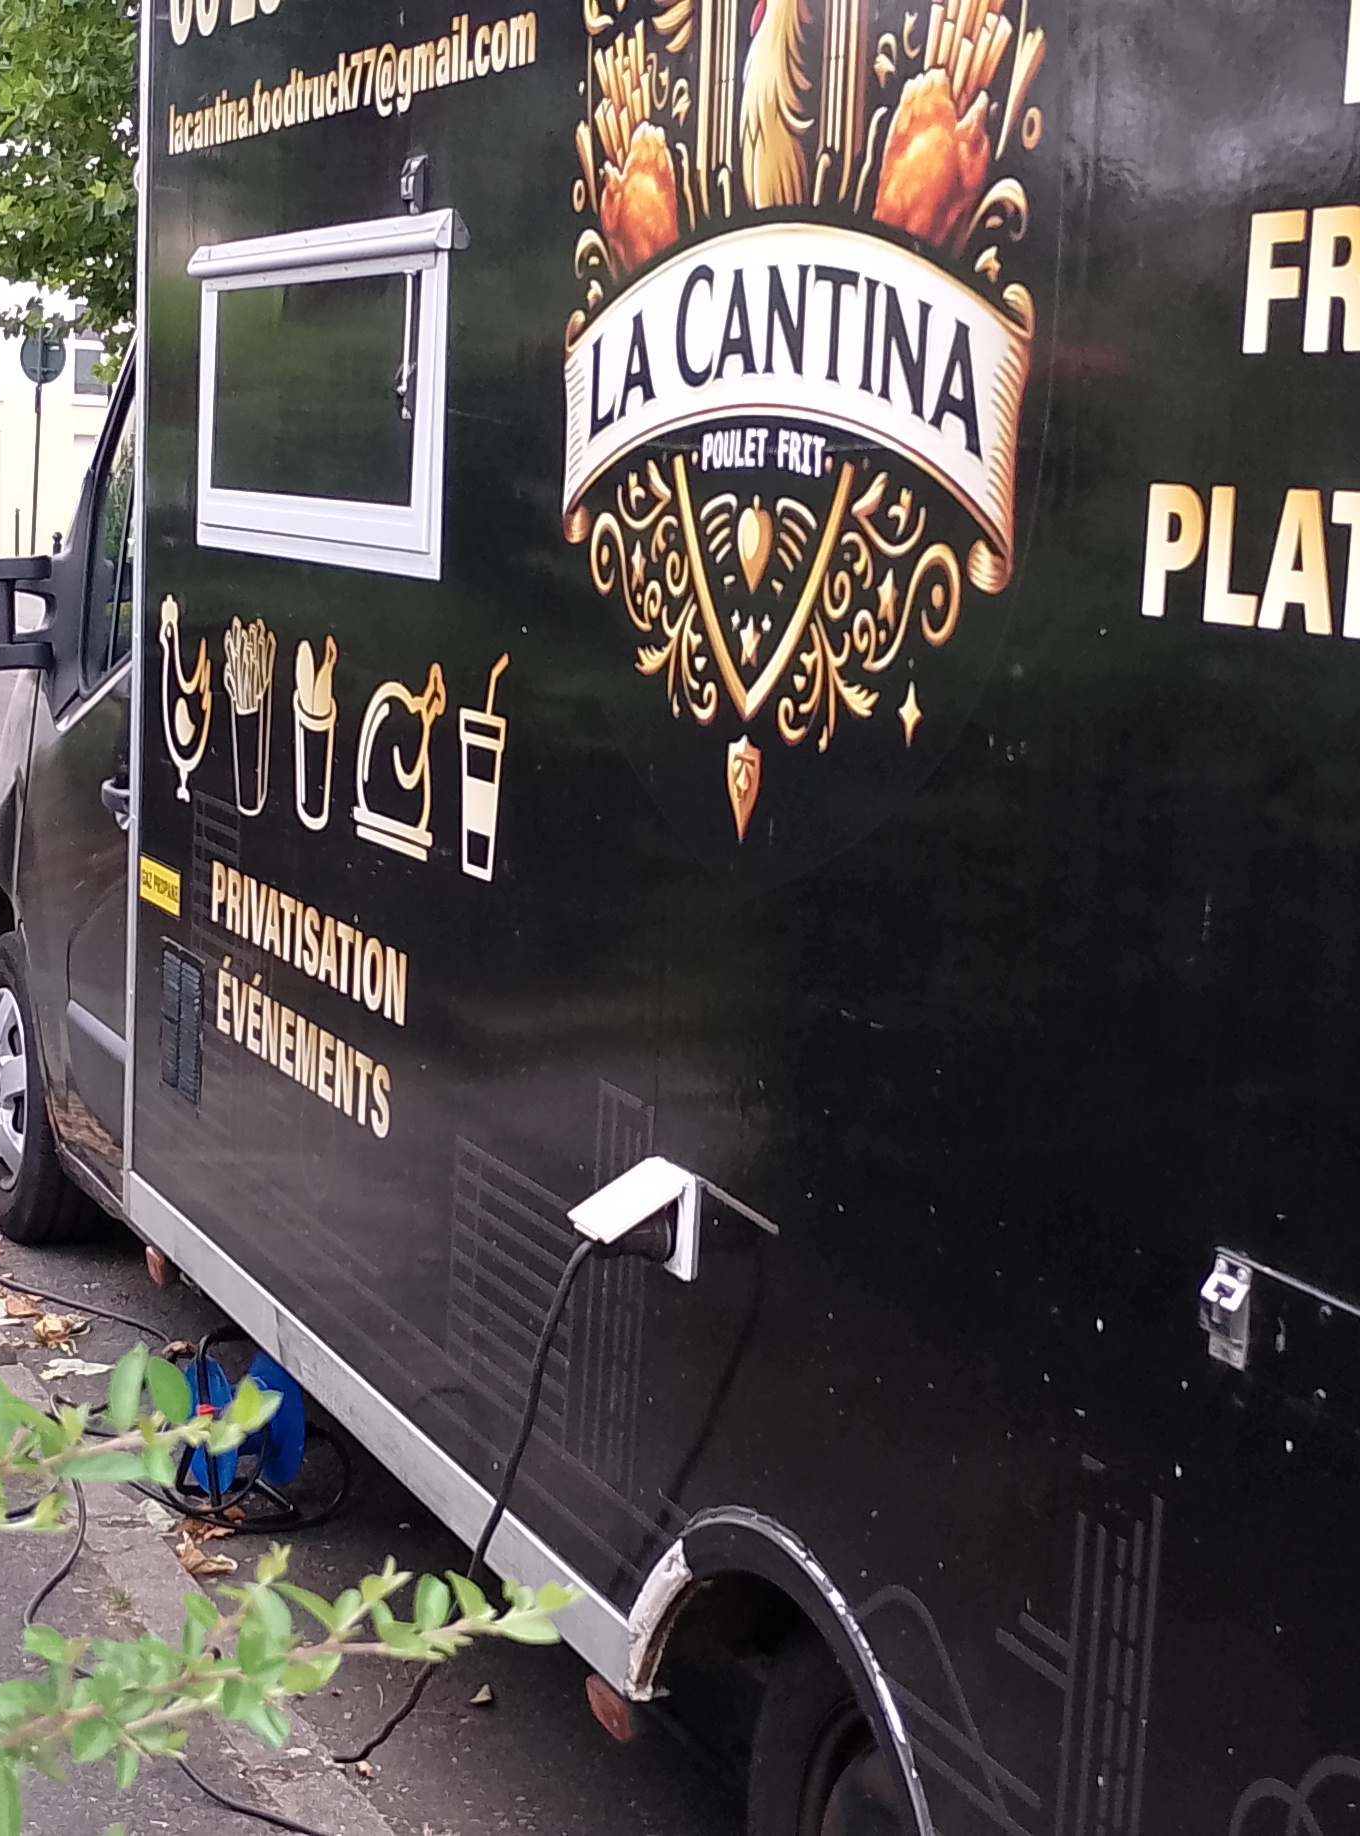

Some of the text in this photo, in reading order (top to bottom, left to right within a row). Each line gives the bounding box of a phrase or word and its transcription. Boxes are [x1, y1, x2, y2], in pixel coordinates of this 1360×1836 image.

[168, 10, 537, 155] lacantina.foodtruck77@gmail.com
[587, 263, 984, 463] LA CANTINA
[701, 427, 827, 477] POULET FRIT
[211, 860, 408, 1026] PRIVATISATION
[216, 956, 392, 1139] ÉVÉNEMENTS
